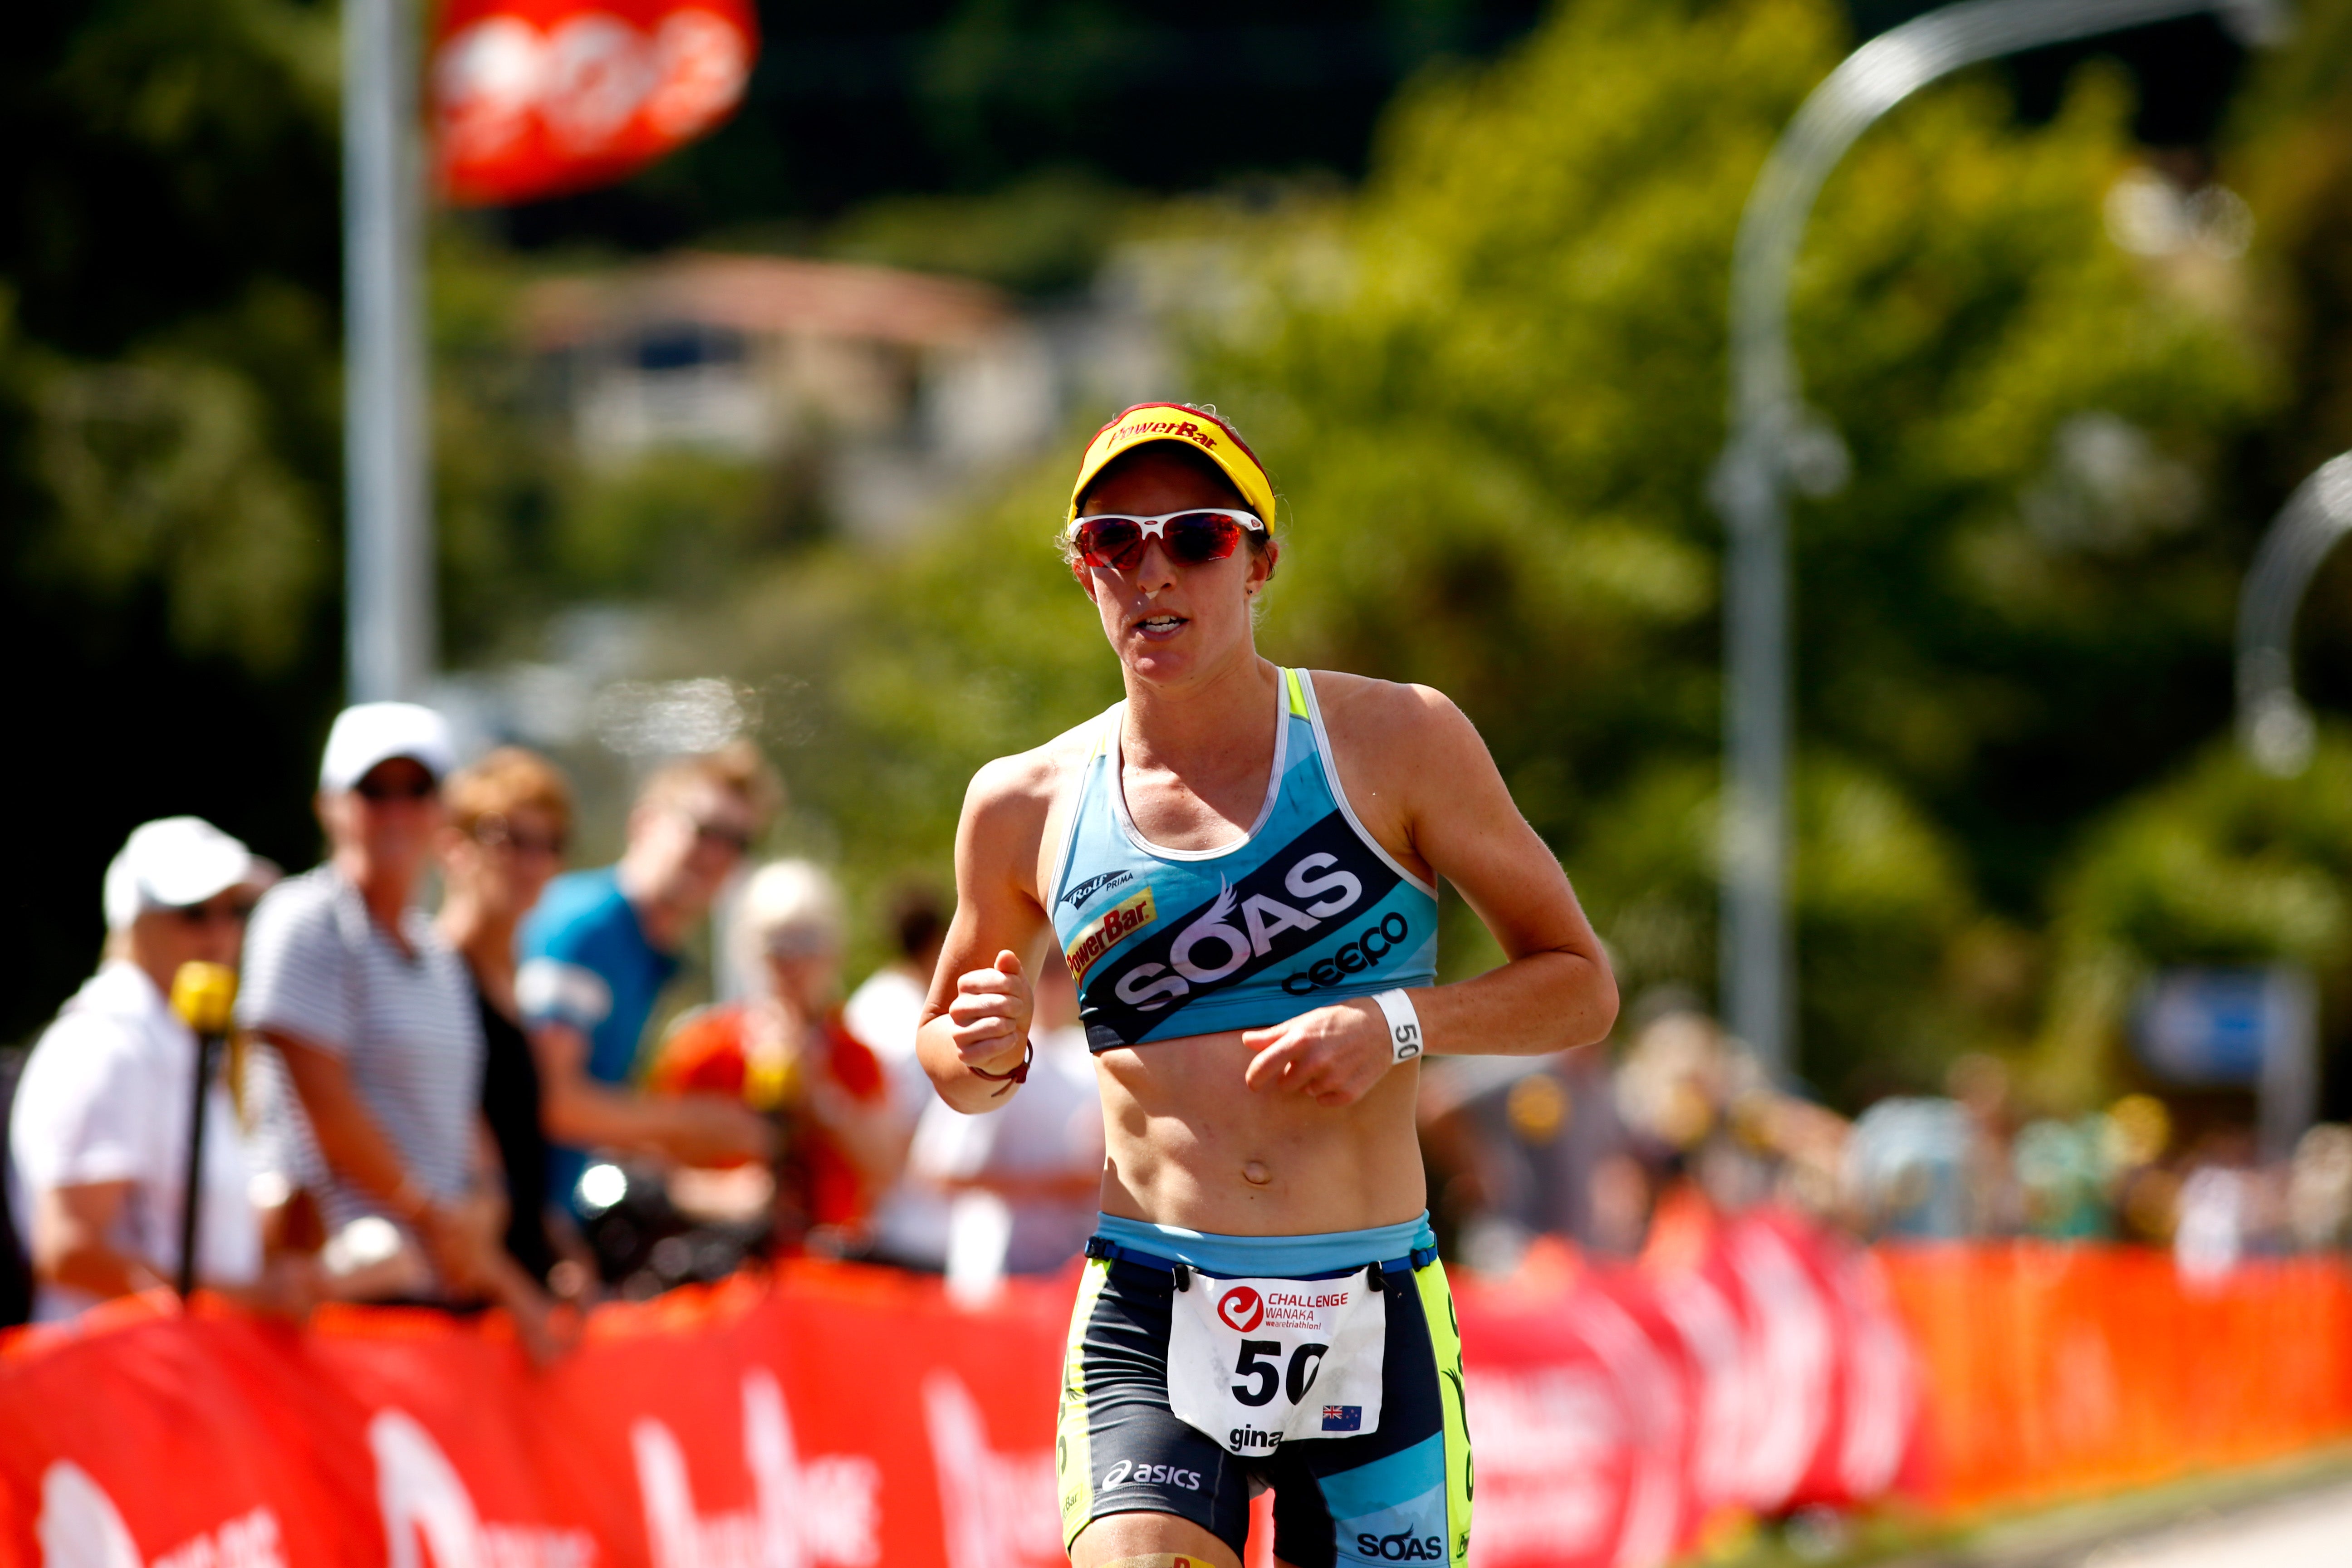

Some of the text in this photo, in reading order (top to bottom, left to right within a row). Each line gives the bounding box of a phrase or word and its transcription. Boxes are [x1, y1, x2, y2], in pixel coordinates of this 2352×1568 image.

[1107, 421, 1217, 451] PowerBar
[1069, 874, 1107, 905] Rolf
[1106, 872, 1133, 892] PRIMA
[1066, 901, 1147, 981] PowerBar
[1115, 852, 1362, 1011] SOAS
[1396, 1024, 1419, 1059] 50
[1265, 1308, 1314, 1321] WANAKA
[1269, 1292, 1348, 1308] CHALLENGE
[1231, 1339, 1329, 1406] 50
[1230, 1424, 1284, 1452] gina
[1357, 1523, 1441, 1561] SOAS
